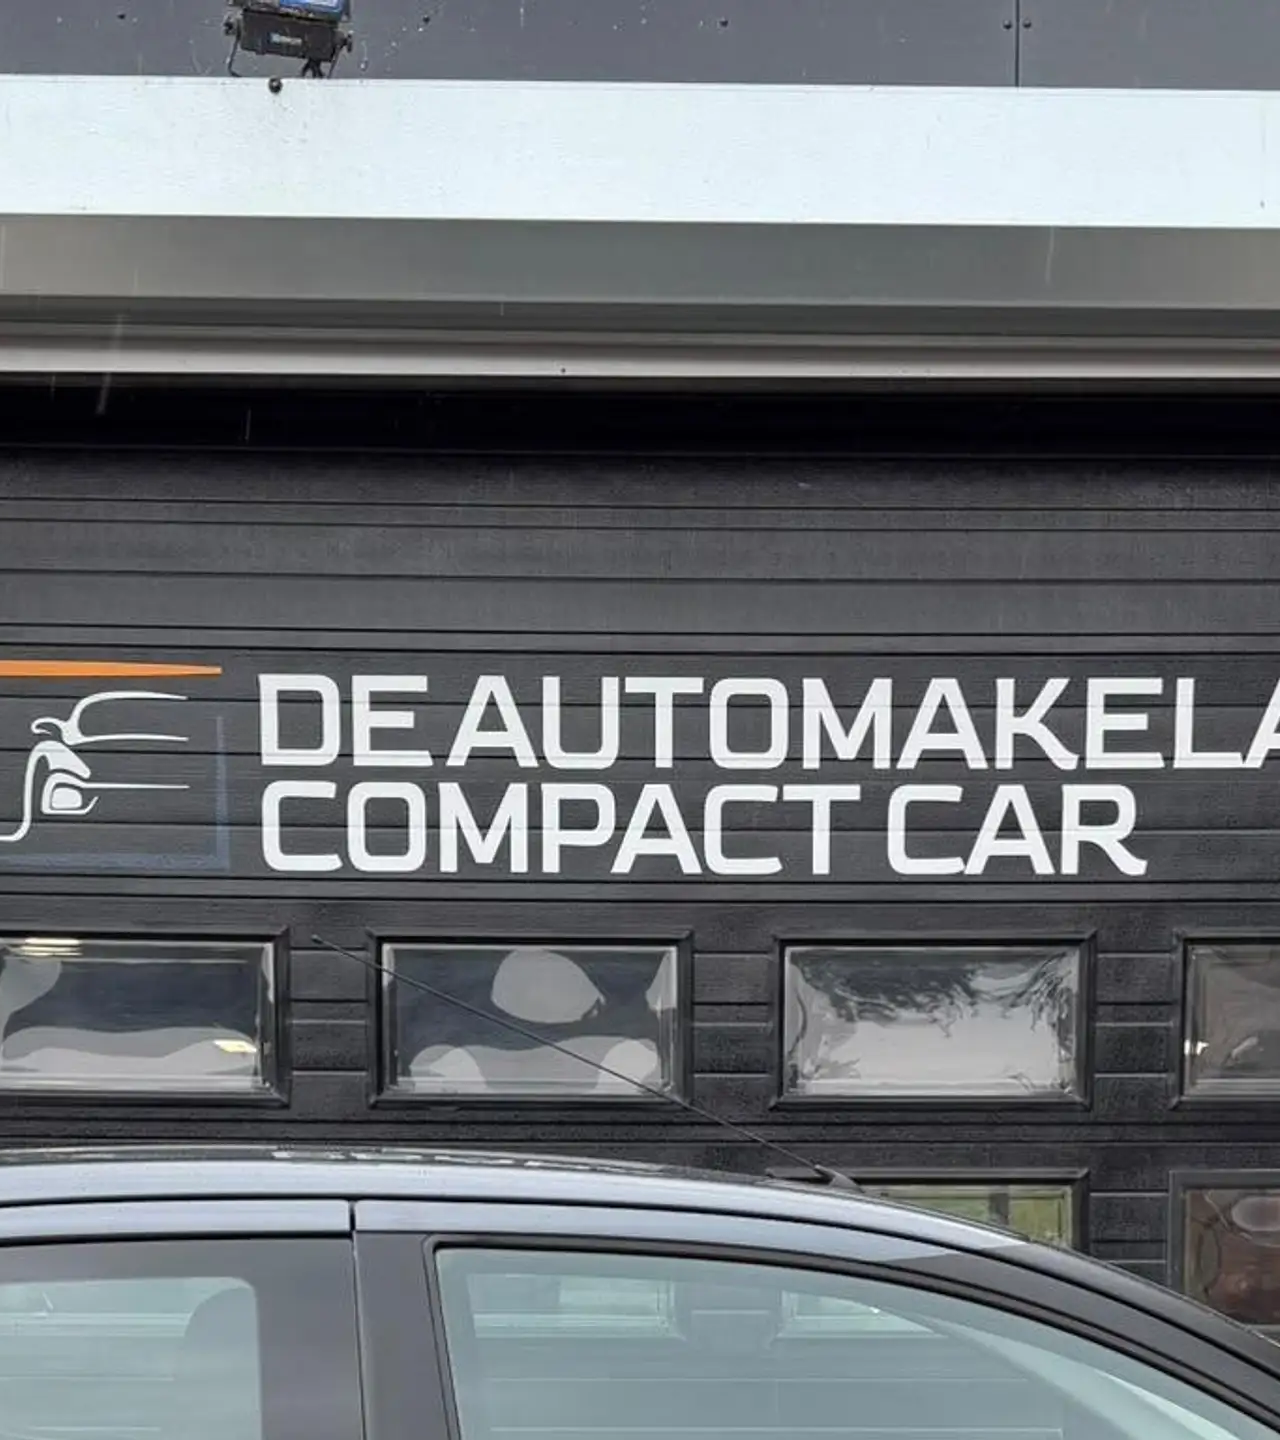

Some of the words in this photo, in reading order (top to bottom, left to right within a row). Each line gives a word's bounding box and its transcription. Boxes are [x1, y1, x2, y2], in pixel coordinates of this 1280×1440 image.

[258, 673, 434, 768] DE
[261, 779, 861, 876] COMPACT
[886, 783, 1148, 876] CAR
